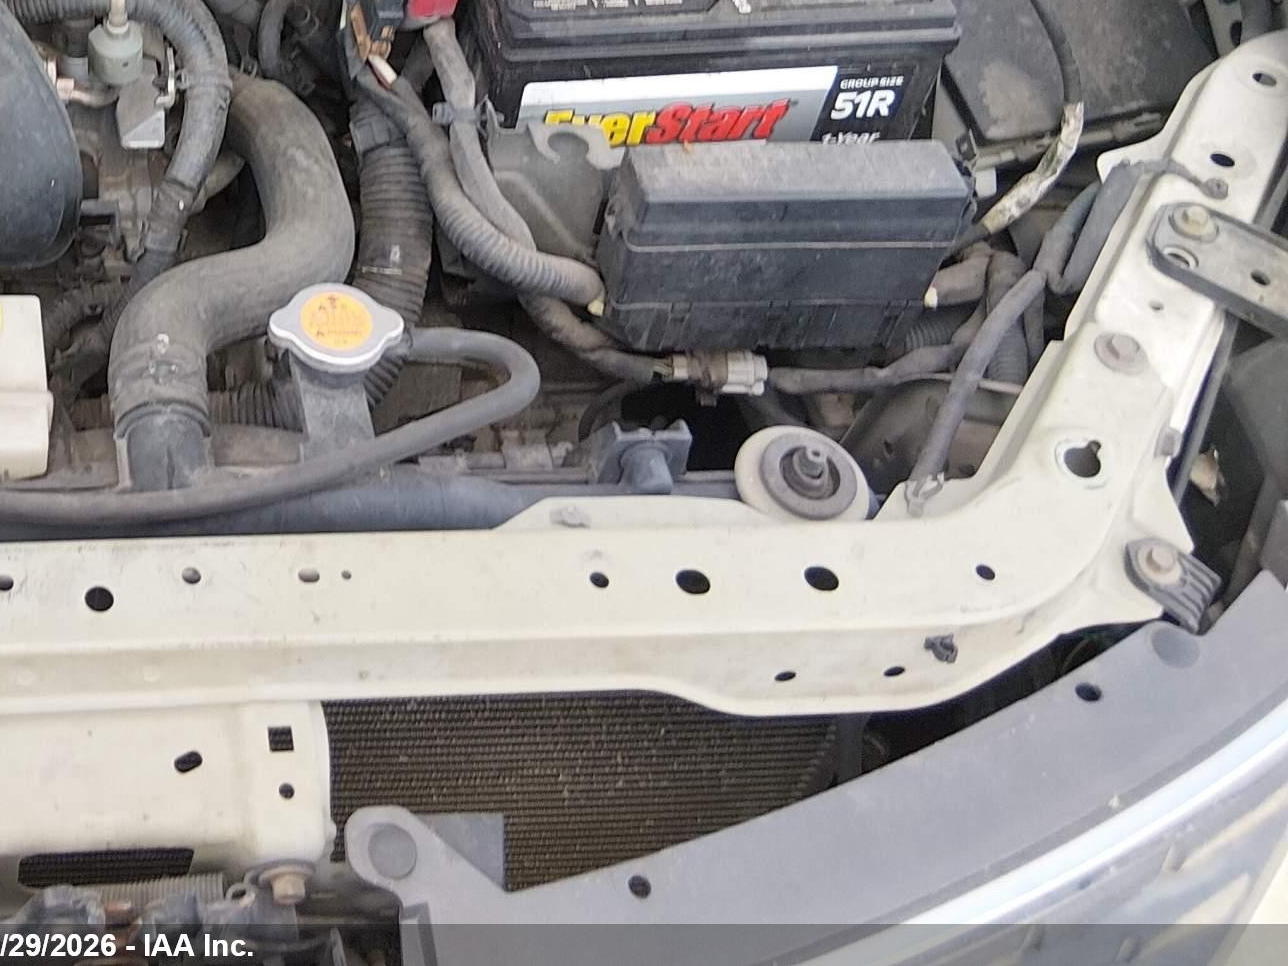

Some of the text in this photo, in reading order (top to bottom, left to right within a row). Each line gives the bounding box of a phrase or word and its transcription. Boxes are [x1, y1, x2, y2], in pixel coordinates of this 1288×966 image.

[840, 76, 904, 90] GROUP SIZE
[830, 89, 895, 120] 51R
